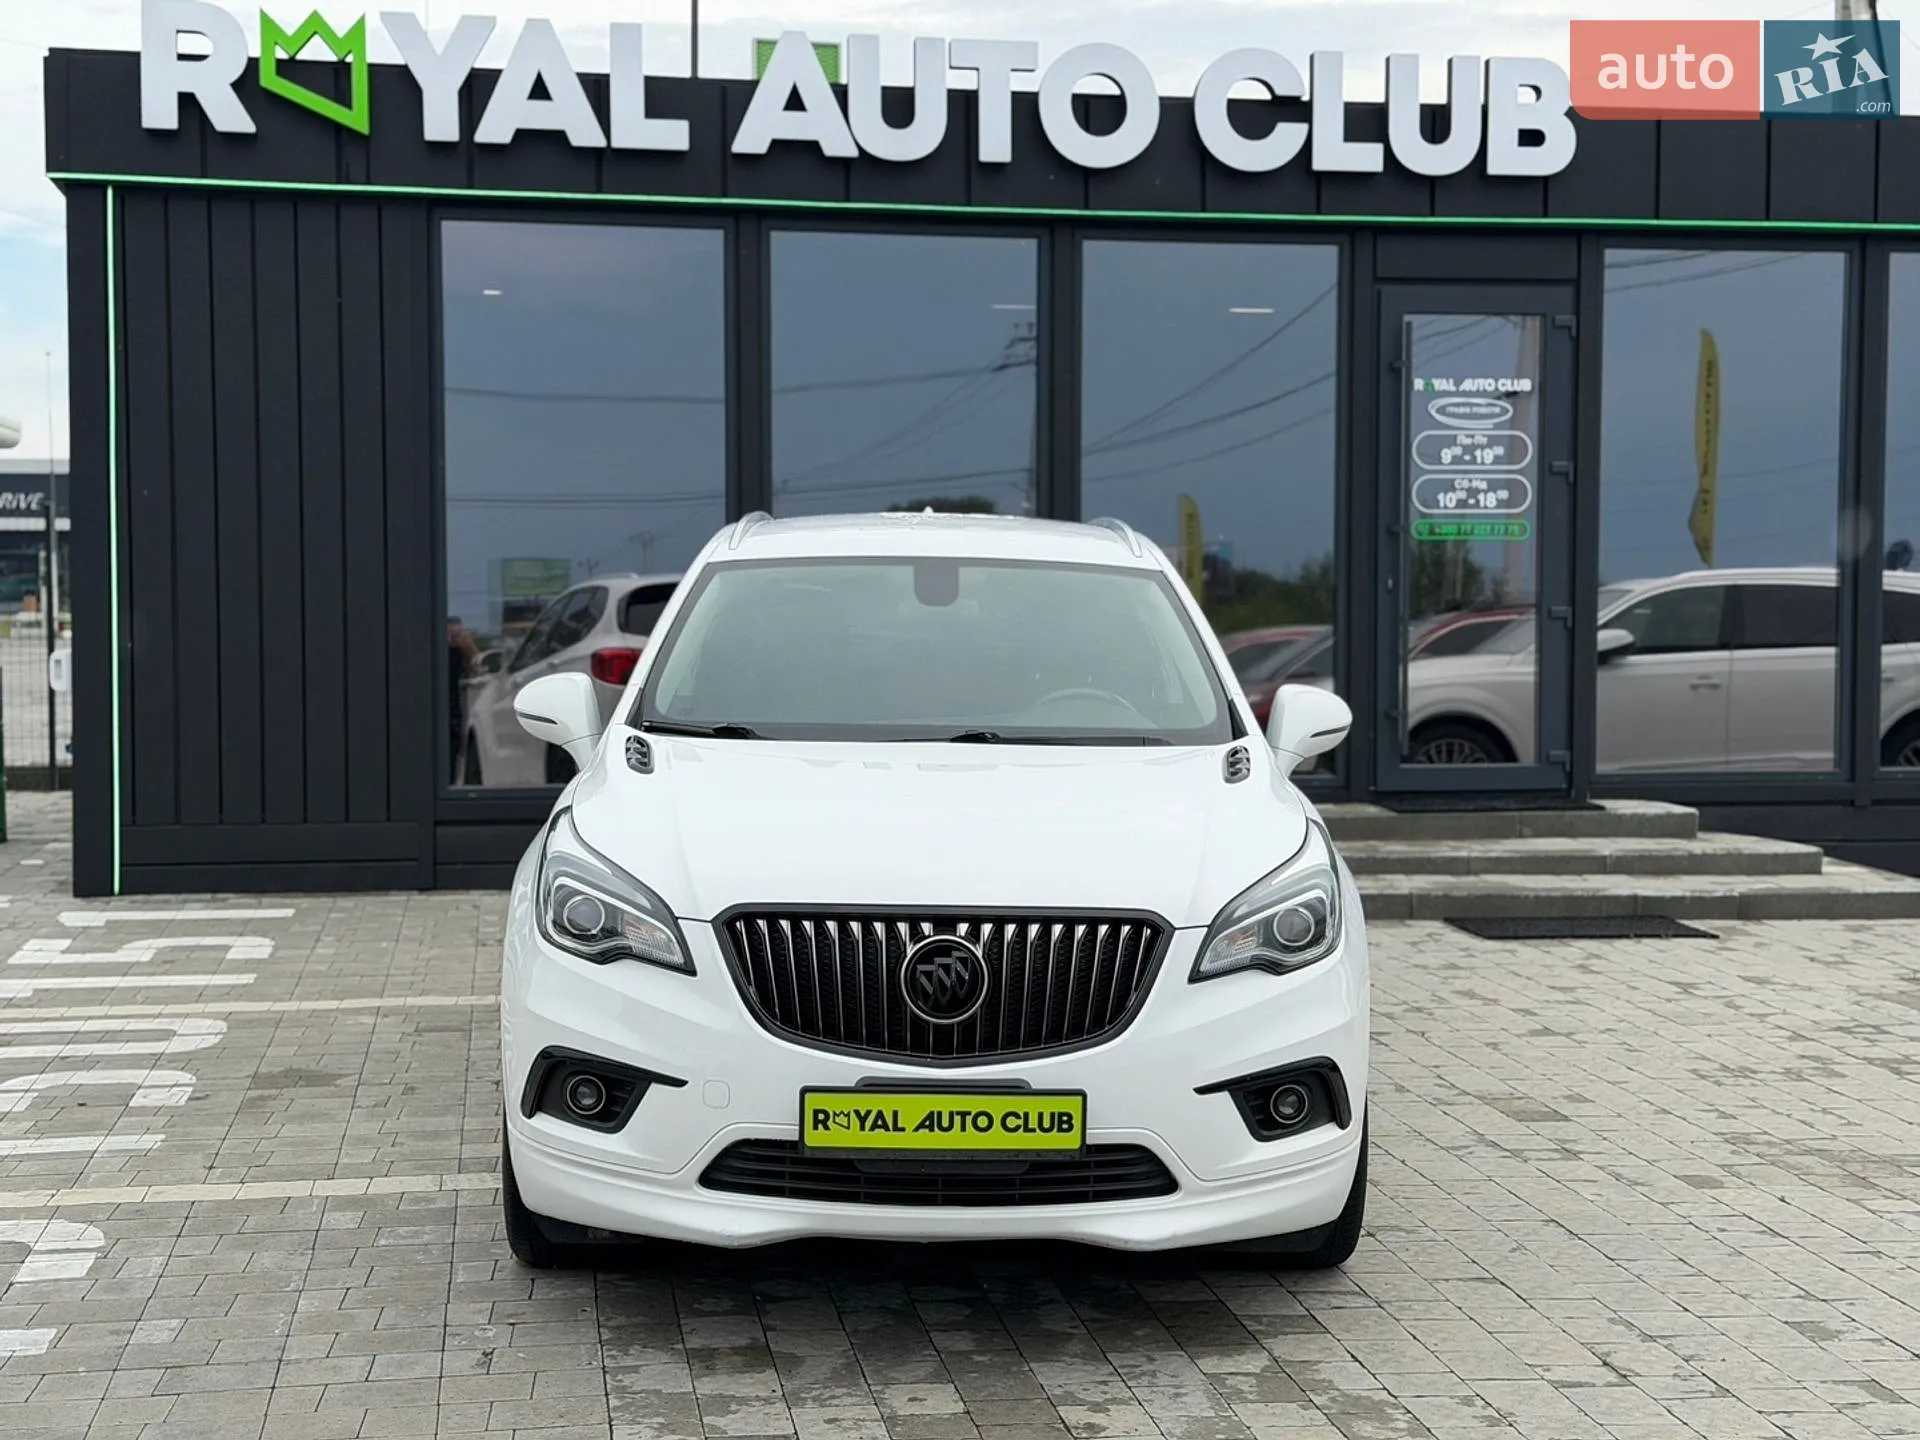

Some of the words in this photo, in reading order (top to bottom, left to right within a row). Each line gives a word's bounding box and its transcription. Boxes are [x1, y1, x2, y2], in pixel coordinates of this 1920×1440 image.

[731, 30, 1161, 169] AUTO
[1193, 48, 1577, 177] CLUB
[1458, 378, 1496, 392] AUTO
[1497, 378, 1532, 392] CLUB
[912, 1109, 995, 1134] AUTO
[1000, 1110, 1075, 1134] CLUB
